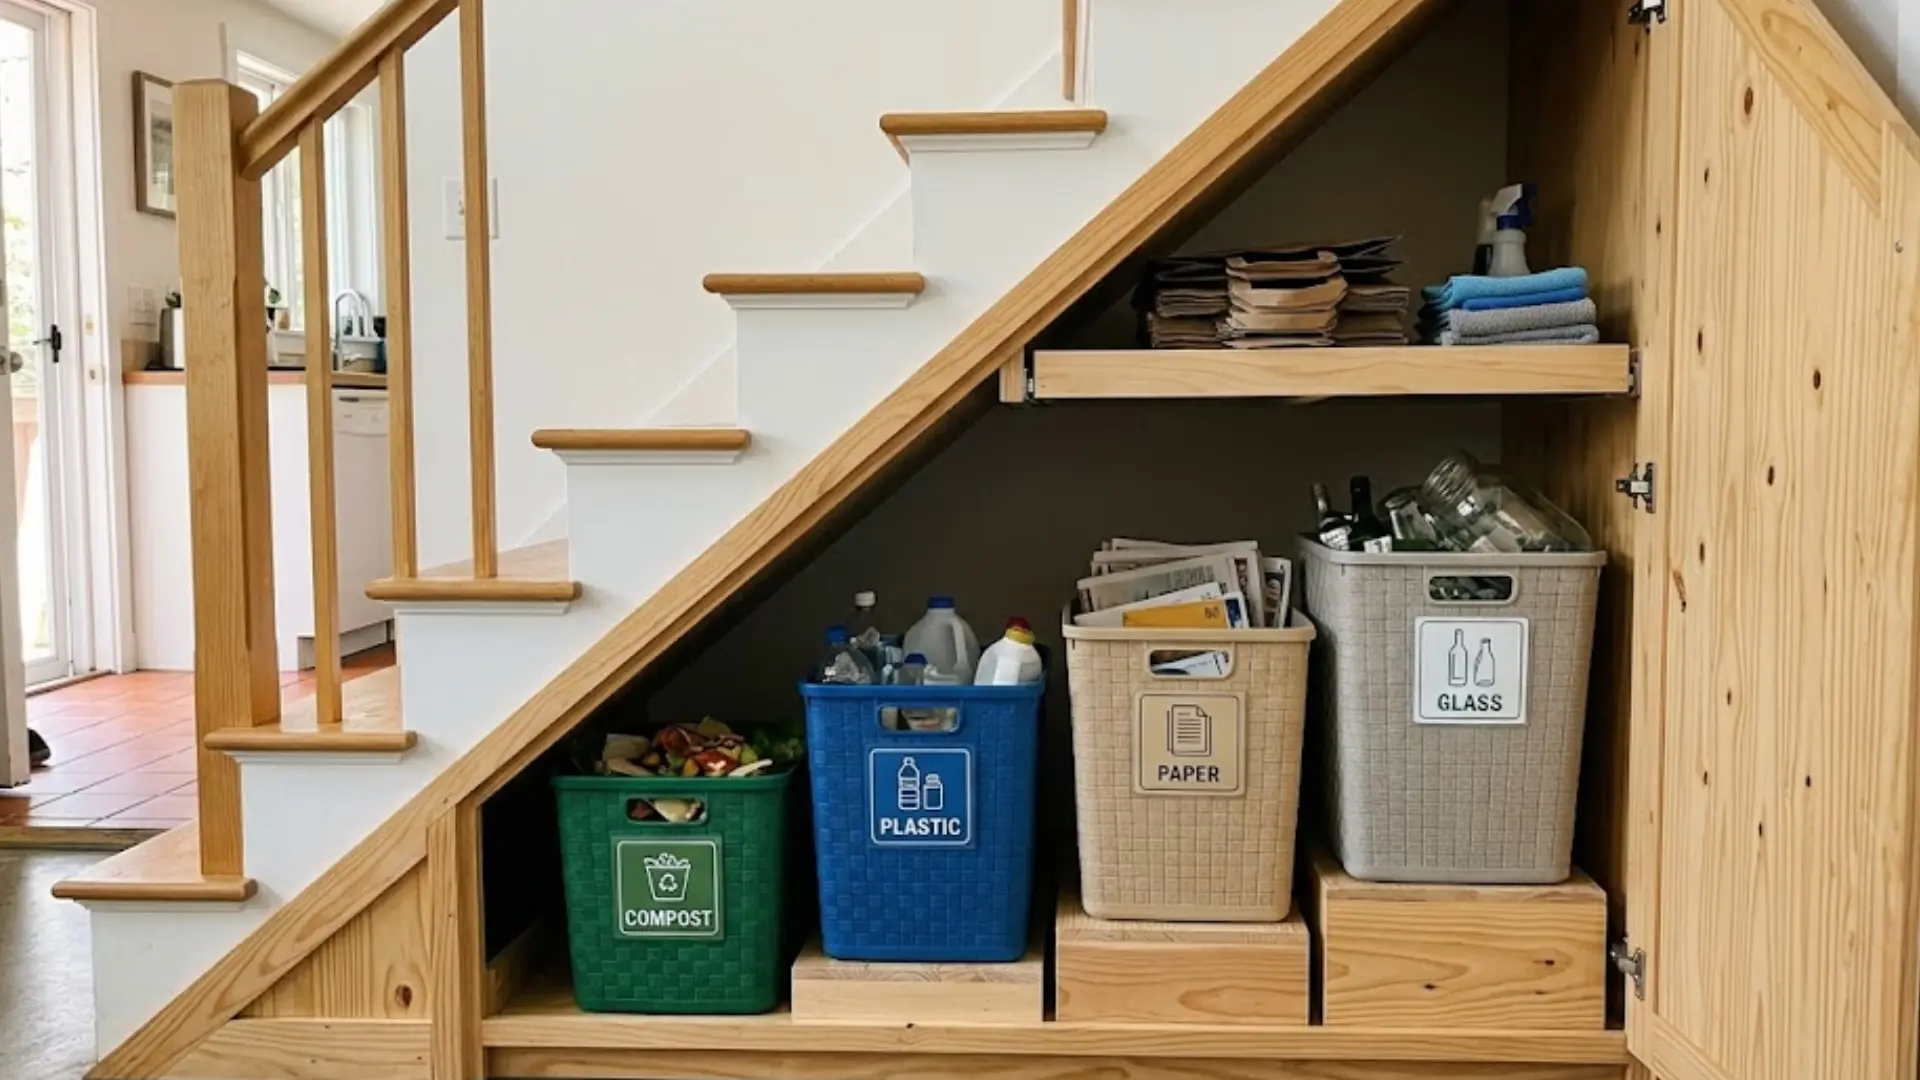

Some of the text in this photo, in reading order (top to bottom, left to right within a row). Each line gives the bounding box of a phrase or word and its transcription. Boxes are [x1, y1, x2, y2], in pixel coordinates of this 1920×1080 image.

[1437, 693, 1503, 712] GLASS
[1158, 764, 1219, 783] PAPER
[880, 817, 961, 836] PLASTIC
[625, 909, 712, 927] COMPOST
